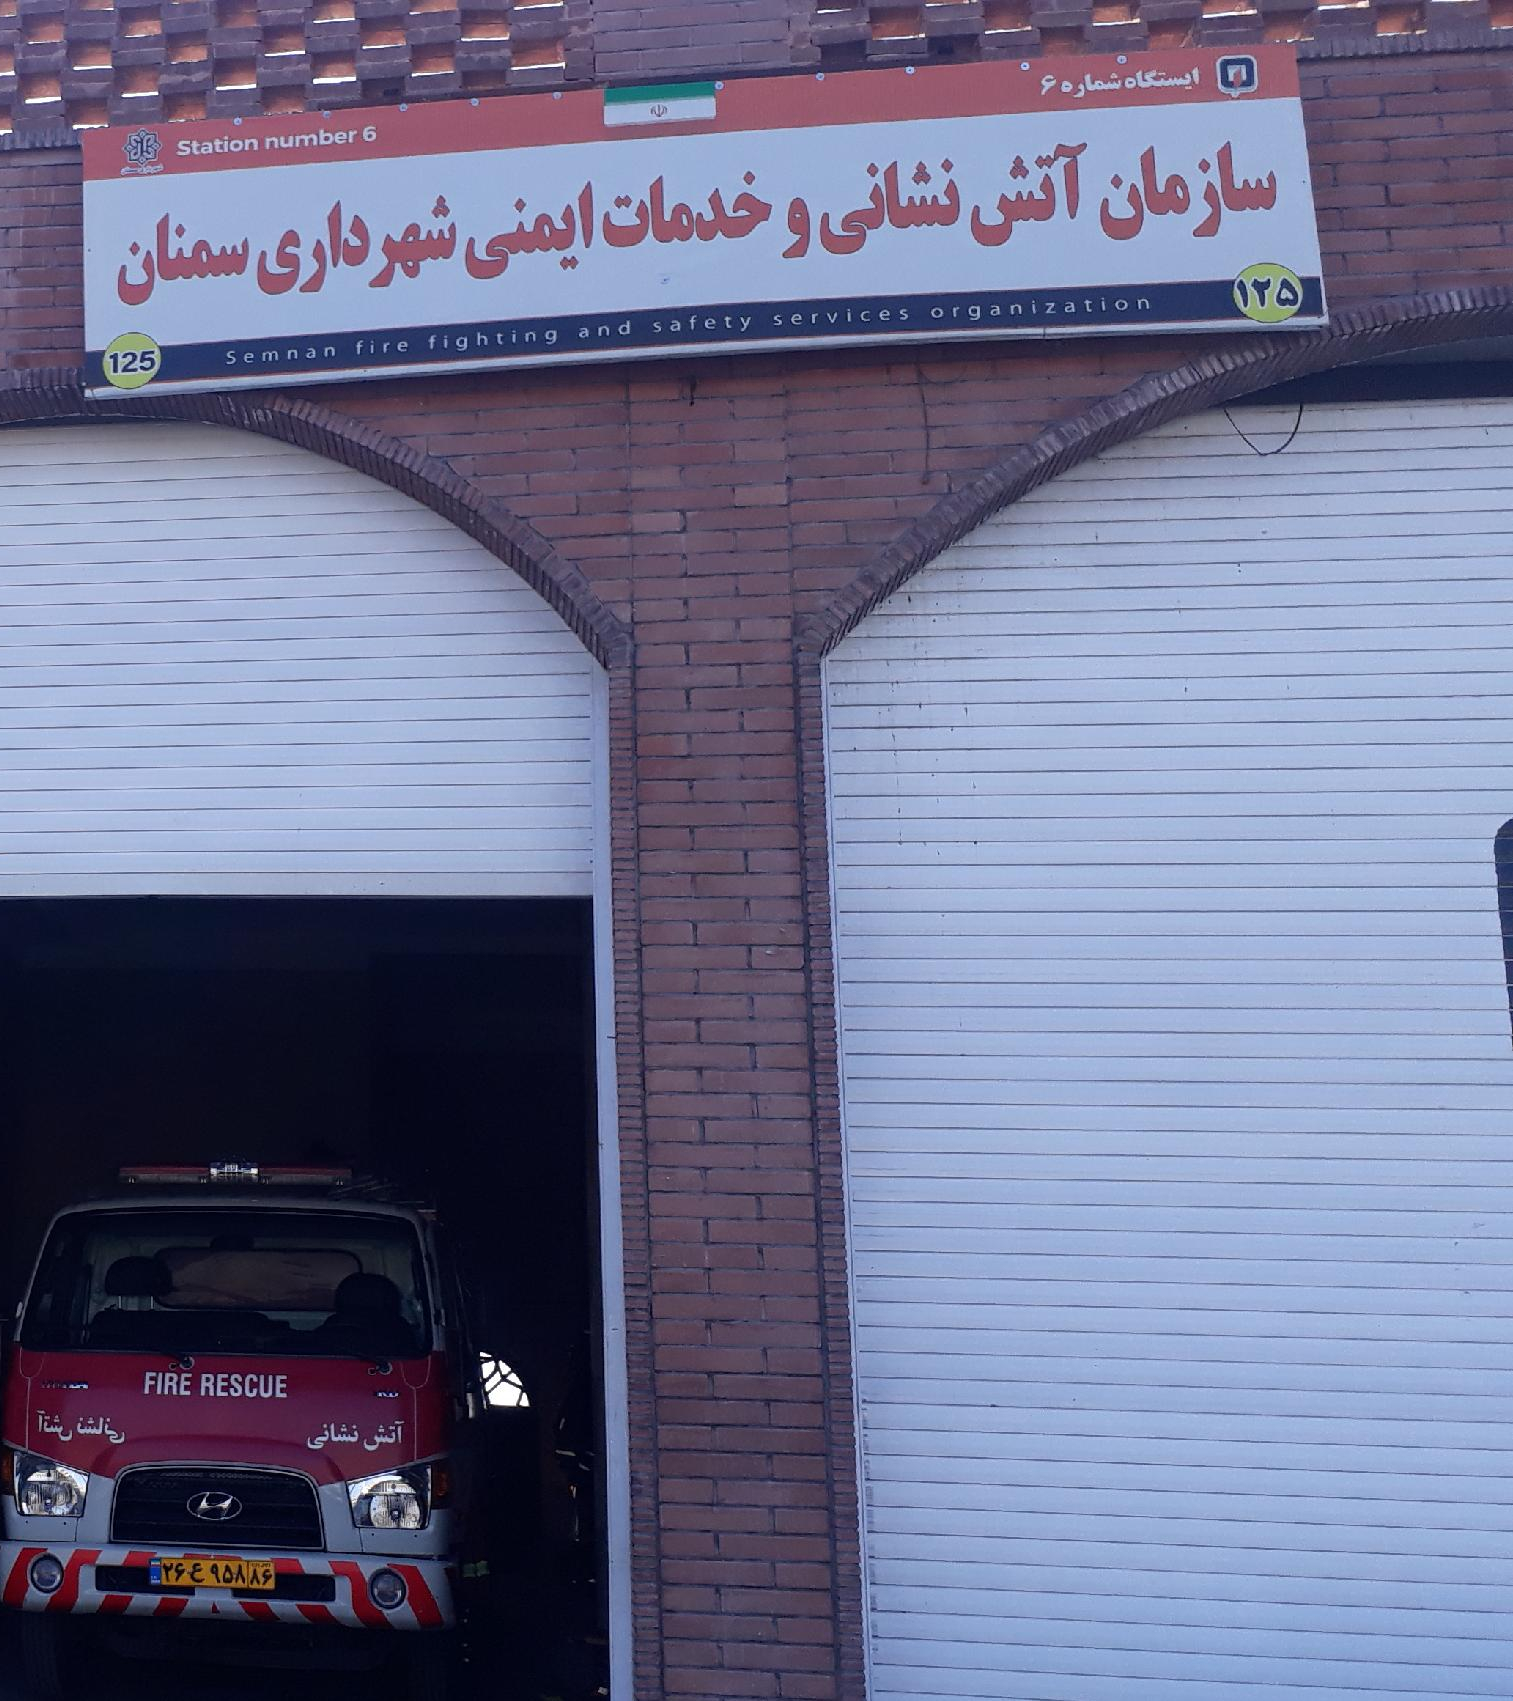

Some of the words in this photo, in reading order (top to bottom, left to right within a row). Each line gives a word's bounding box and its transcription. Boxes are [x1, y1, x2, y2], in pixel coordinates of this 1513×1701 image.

[1041, 74, 1057, 96] ۶
[1061, 72, 1122, 98] شماره
[1124, 66, 1200, 90] ایستگاه
[176, 135, 258, 156] Station
[264, 128, 358, 149] number
[362, 126, 377, 142] 6
[819, 158, 961, 255] نشانی
[970, 142, 1087, 247] آتش
[1099, 141, 1278, 241] سازمان
[602, 170, 773, 248] خدمات
[465, 180, 595, 280] ایمنی
[782, 197, 811, 259] و
[117, 212, 250, 306] سمنان
[1235, 276, 1300, 309] ۱۲۵
[225, 345, 337, 365] Semnan
[356, 339, 409, 355] fire
[428, 329, 558, 352] fighting
[578, 320, 632, 339] and
[652, 314, 752, 333] safety
[773, 307, 909, 327] services
[930, 296, 1151, 321] organization
[108, 349, 157, 374] 125
[143, 1372, 193, 1396] FIRE
[200, 1373, 288, 1398] RESCUE
[307, 1422, 359, 1450] نشانی
[363, 1420, 405, 1451] آتش
